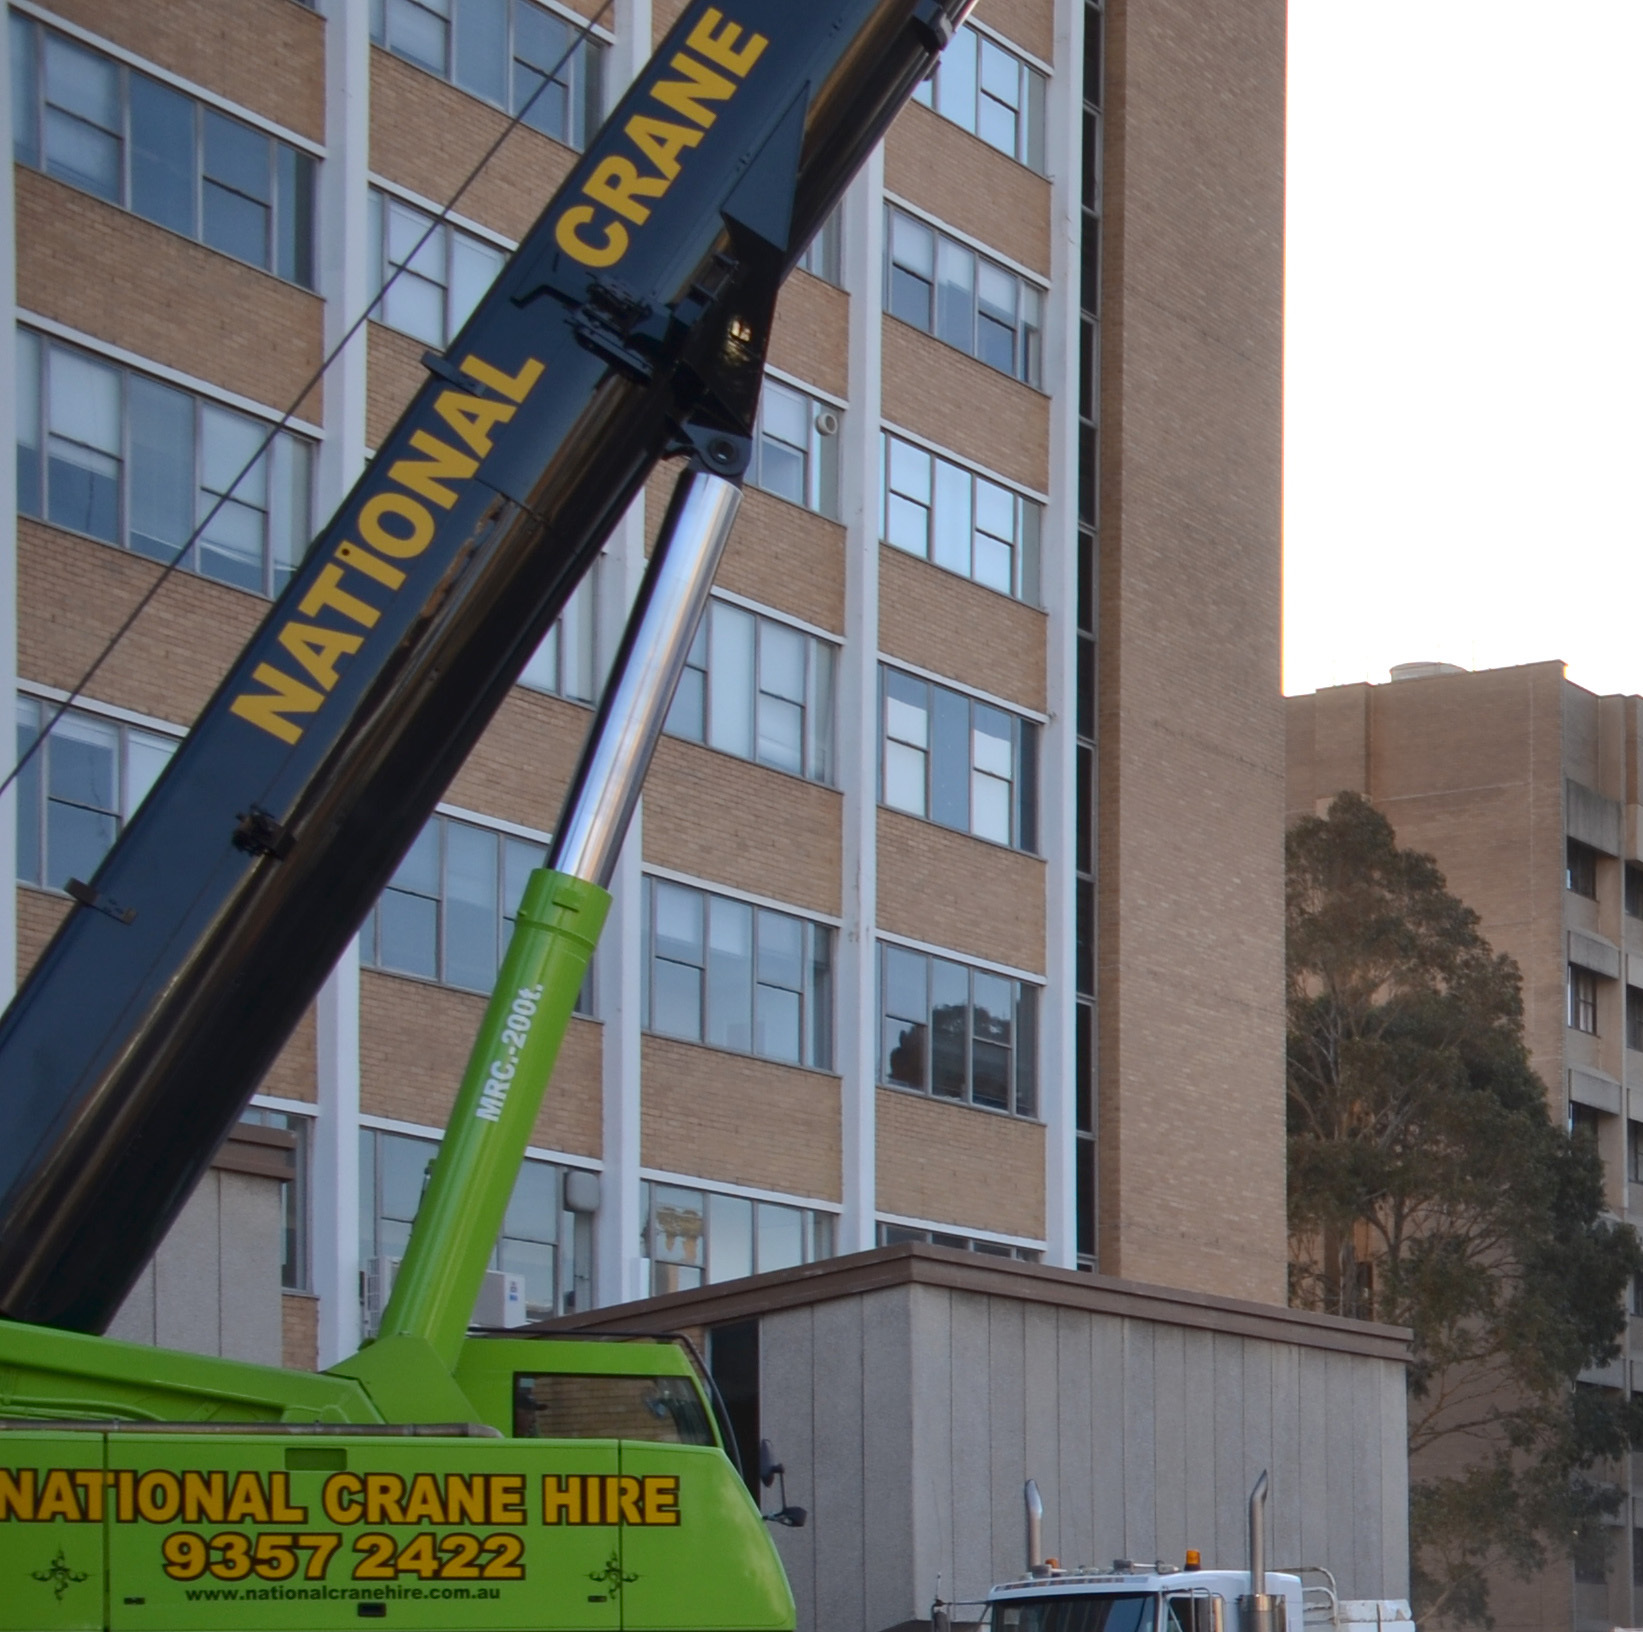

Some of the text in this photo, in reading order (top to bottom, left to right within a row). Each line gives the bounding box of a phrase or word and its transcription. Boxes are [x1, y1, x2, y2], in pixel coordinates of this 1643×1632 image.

[231, 8, 768, 744] NATIONAL CRANE
[0, 1468, 681, 1527] NATIONAL CRANE HIRE
[162, 1531, 526, 1582] 9357 2422
[186, 1584, 500, 1602] www.nationalcranehire.com.au
